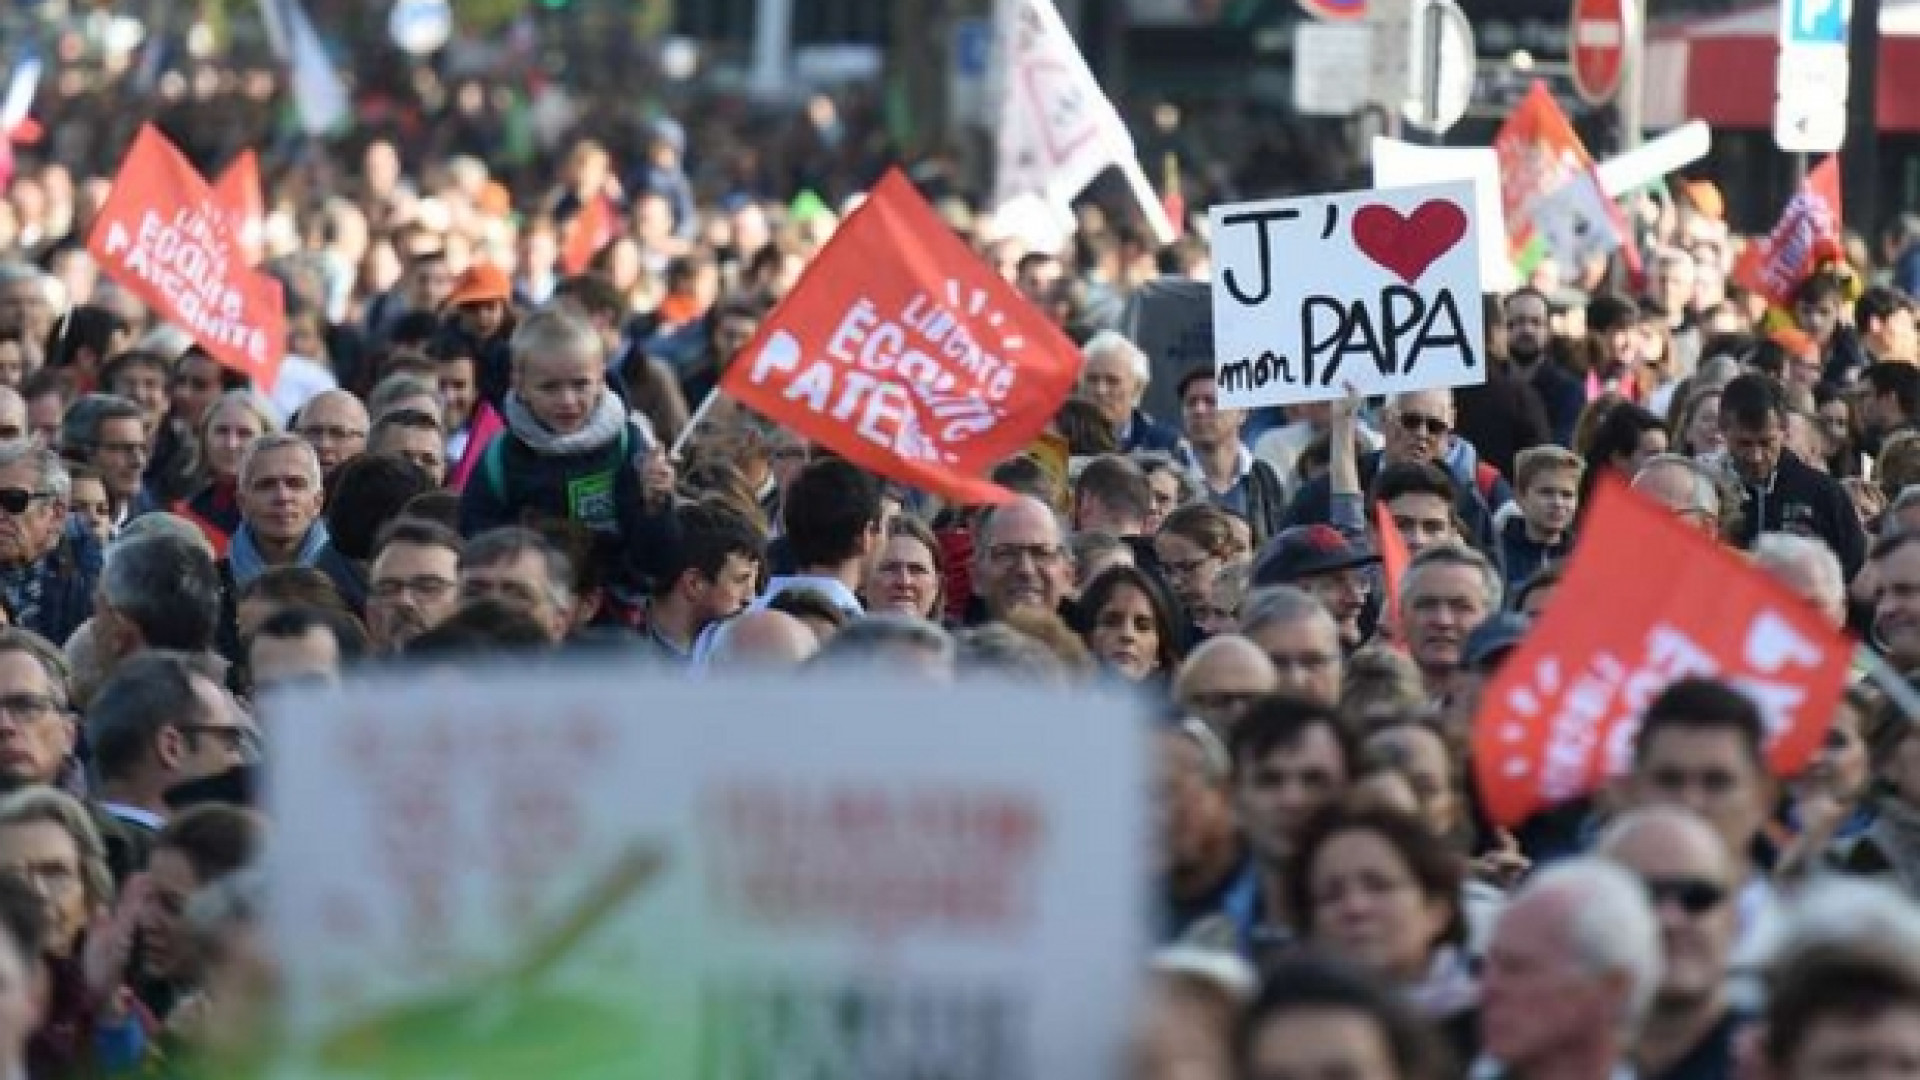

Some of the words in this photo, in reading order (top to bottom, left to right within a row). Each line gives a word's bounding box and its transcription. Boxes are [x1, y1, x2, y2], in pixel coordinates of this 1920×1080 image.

[1221, 204, 1339, 306] J'
[1218, 350, 1297, 394] mon
[1301, 284, 1476, 387] PAPA
